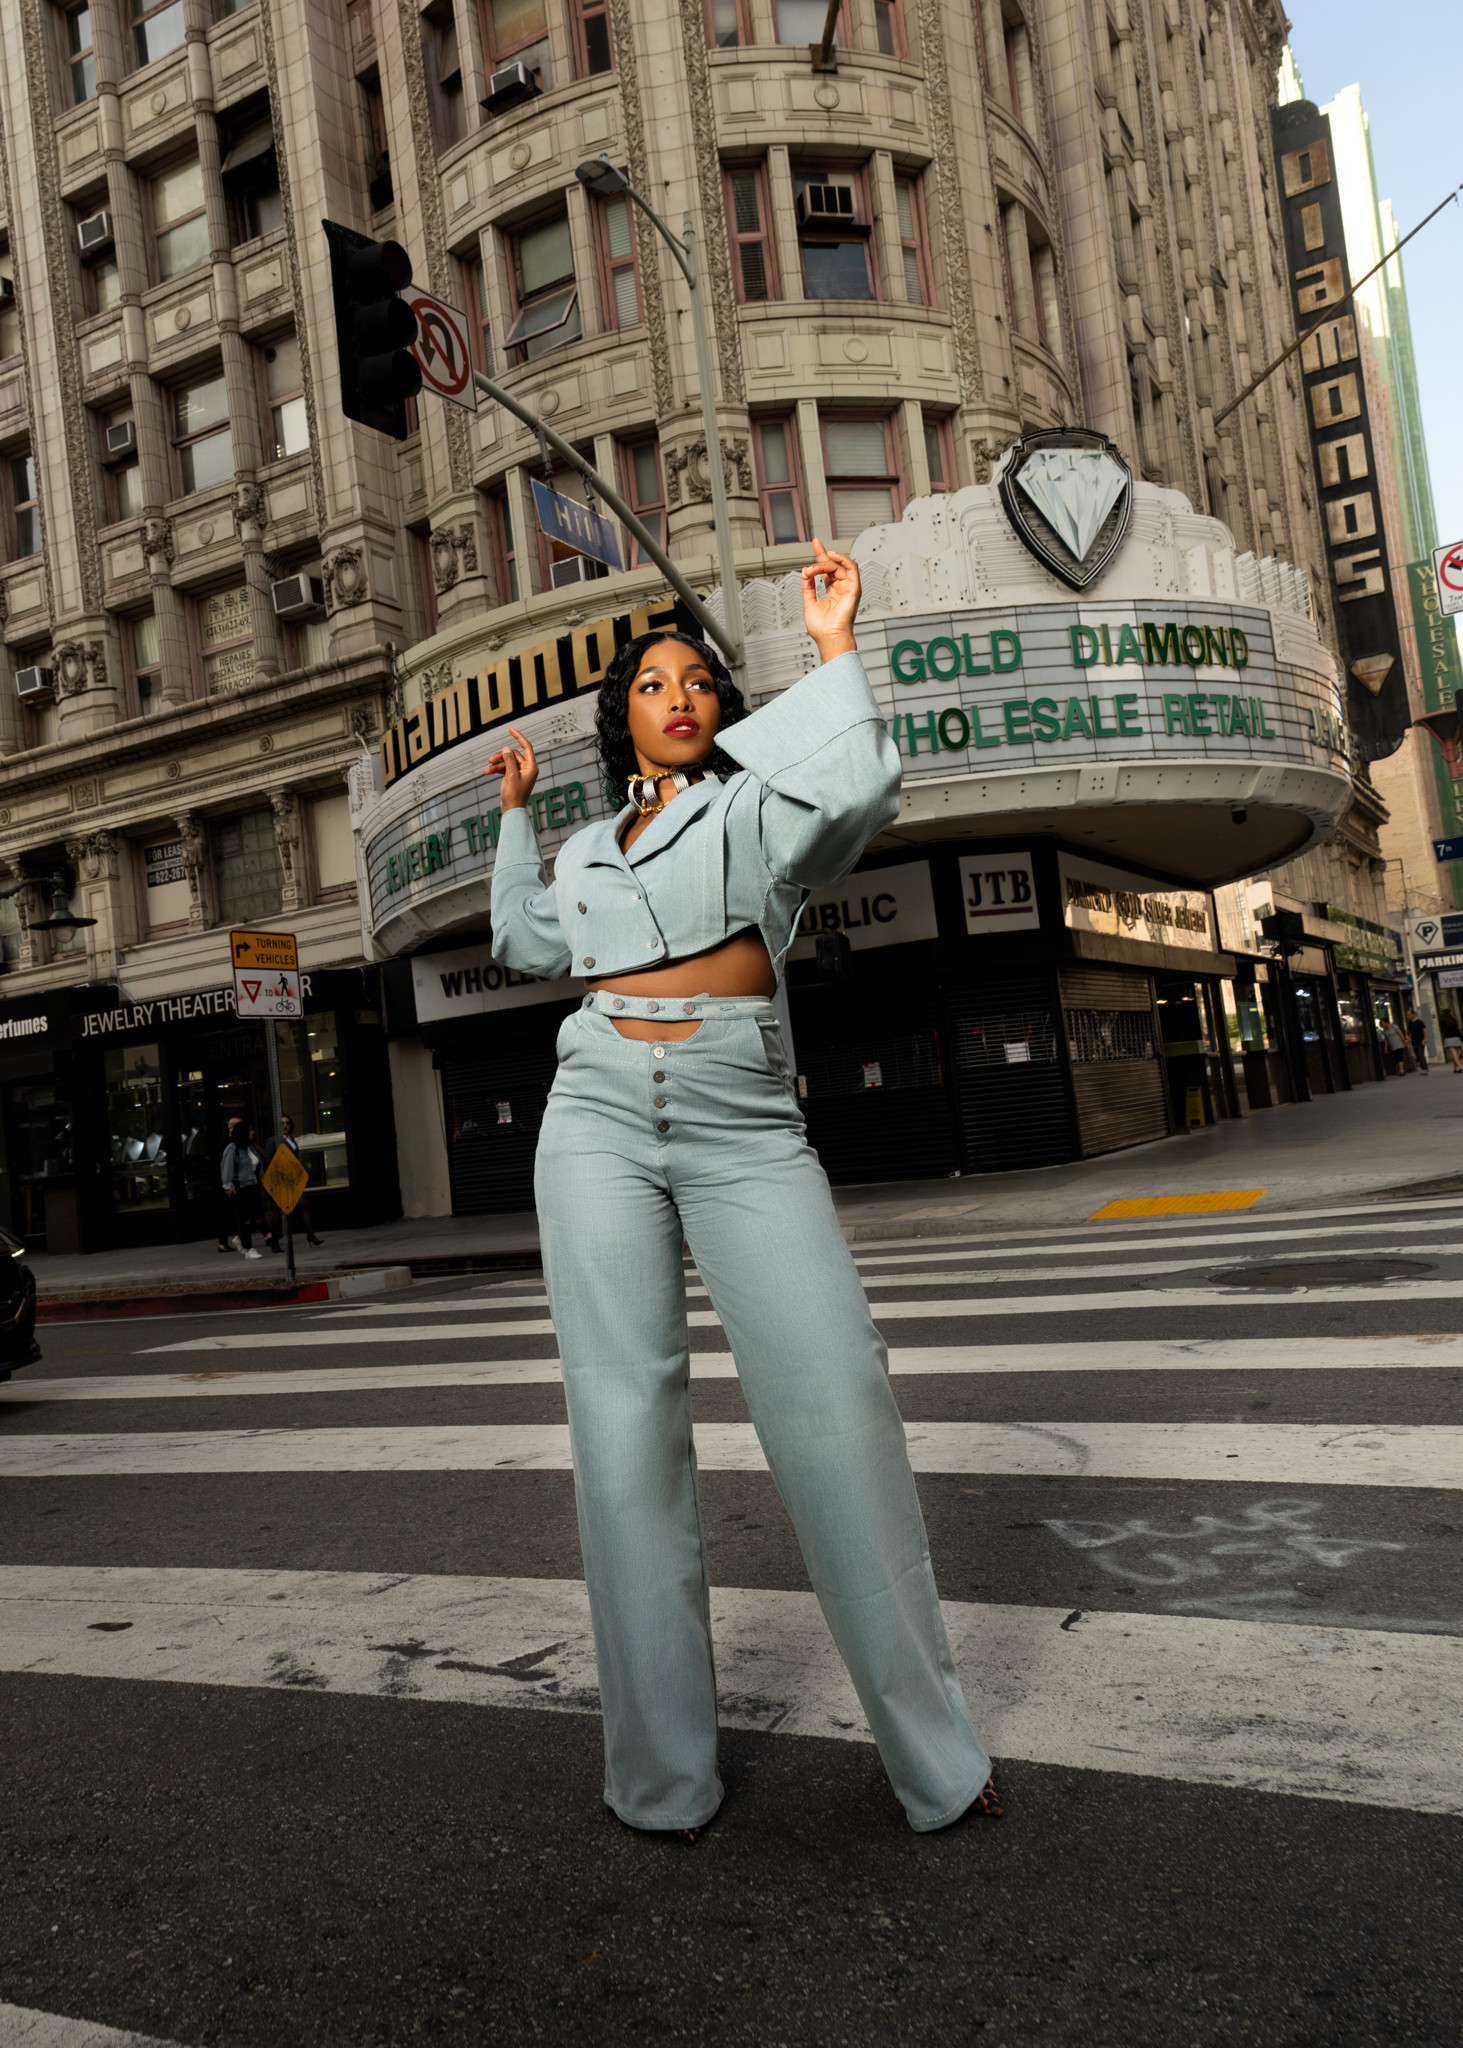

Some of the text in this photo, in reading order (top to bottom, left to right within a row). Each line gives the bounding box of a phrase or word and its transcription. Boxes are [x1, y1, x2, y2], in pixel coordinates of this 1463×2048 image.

[554, 501, 602, 547] Hill
[206, 616, 252, 638] (213)622-69
[219, 650, 251, 667] REPAIRS
[891, 623, 1249, 684] GOLD DIAMOND
[209, 660, 256, 681] SPECIAL ORDE
[210, 676, 254, 696] REPARACIO
[1162, 693, 1276, 738] RETAIL
[164, 844, 182, 857] LEAS
[385, 826, 452, 894] JEWELRY
[460, 780, 588, 855] THETER
[155, 866, 185, 883] 622-267
[968, 870, 1031, 908] JTB
[1064, 876, 1113, 914] DIAMOND
[798, 893, 898, 932] UBLIC
[256, 938, 292, 950] TURNING
[255, 953, 296, 965] VEHICLES
[265, 988, 273, 997] TO
[82, 991, 237, 1037] JEWELRY THEATER
[209, 1027, 300, 1062] ENTRACE
